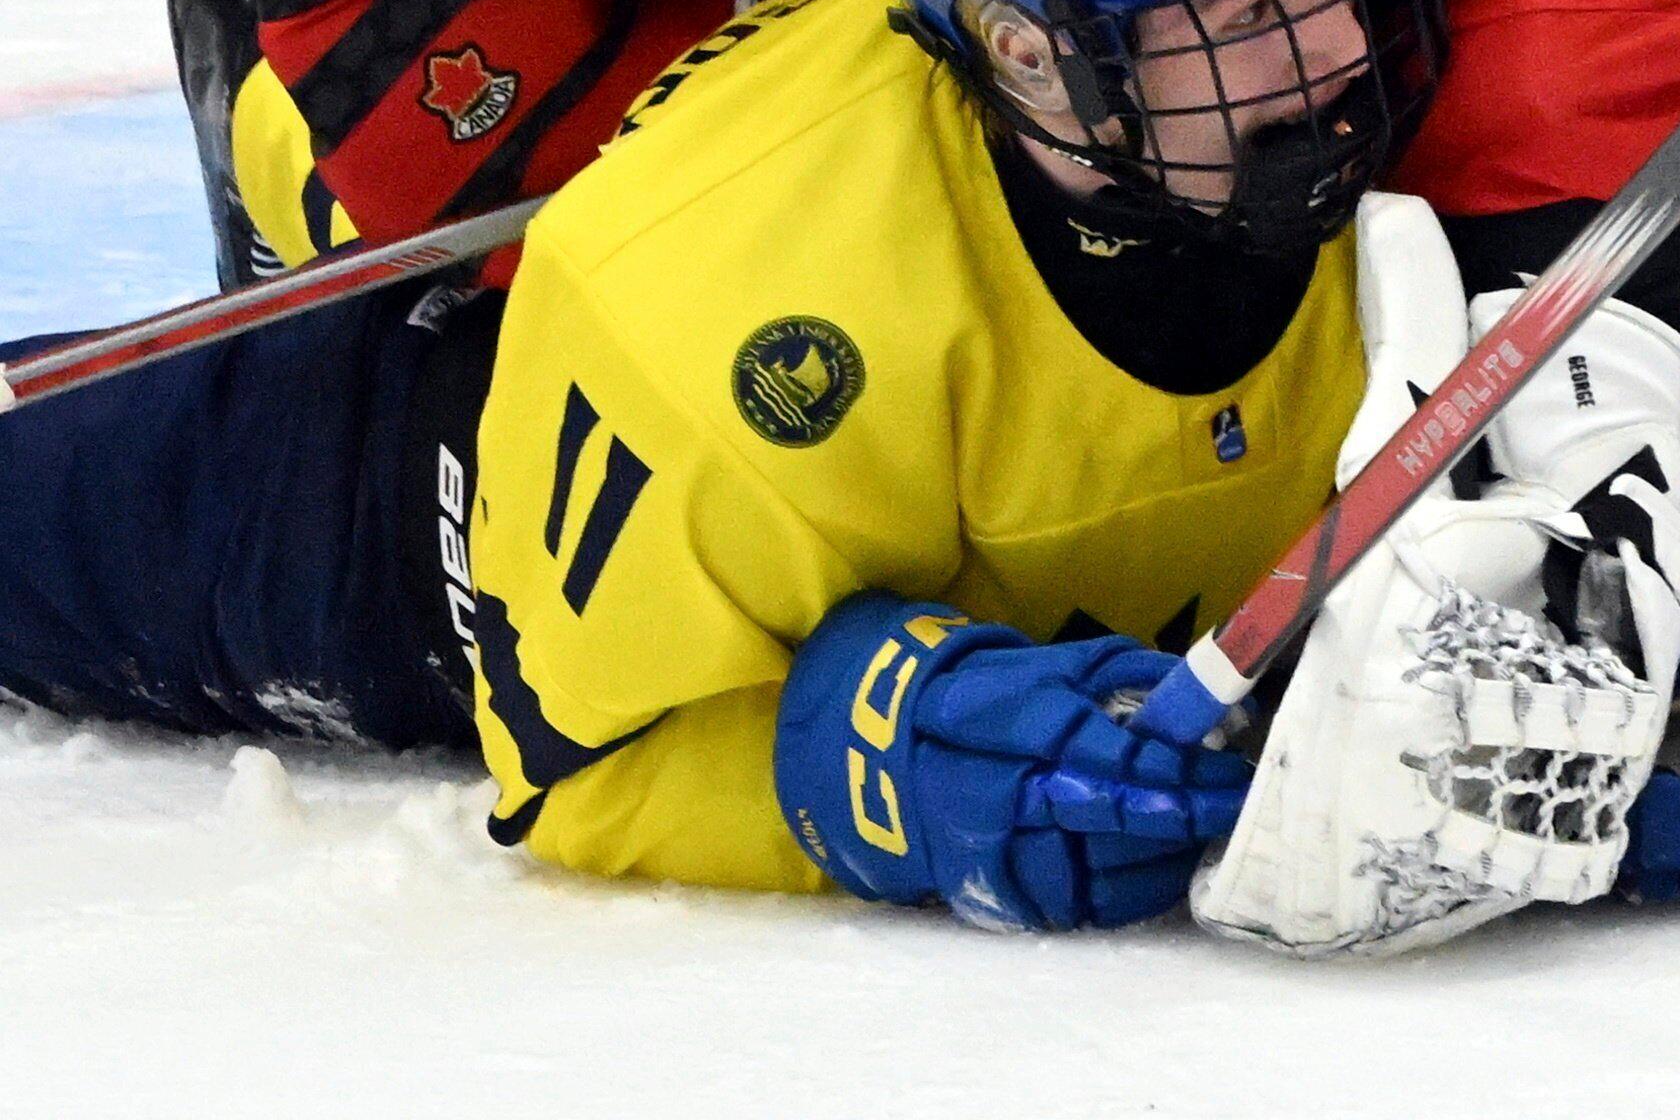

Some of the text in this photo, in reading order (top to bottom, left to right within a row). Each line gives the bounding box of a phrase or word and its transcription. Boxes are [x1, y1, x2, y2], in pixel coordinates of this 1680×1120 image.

[457, 79, 515, 137] CANADA
[1395, 338, 1525, 477] HYPERLITE
[1567, 354, 1596, 409] GEORGE
[438, 442, 480, 675] BAU
